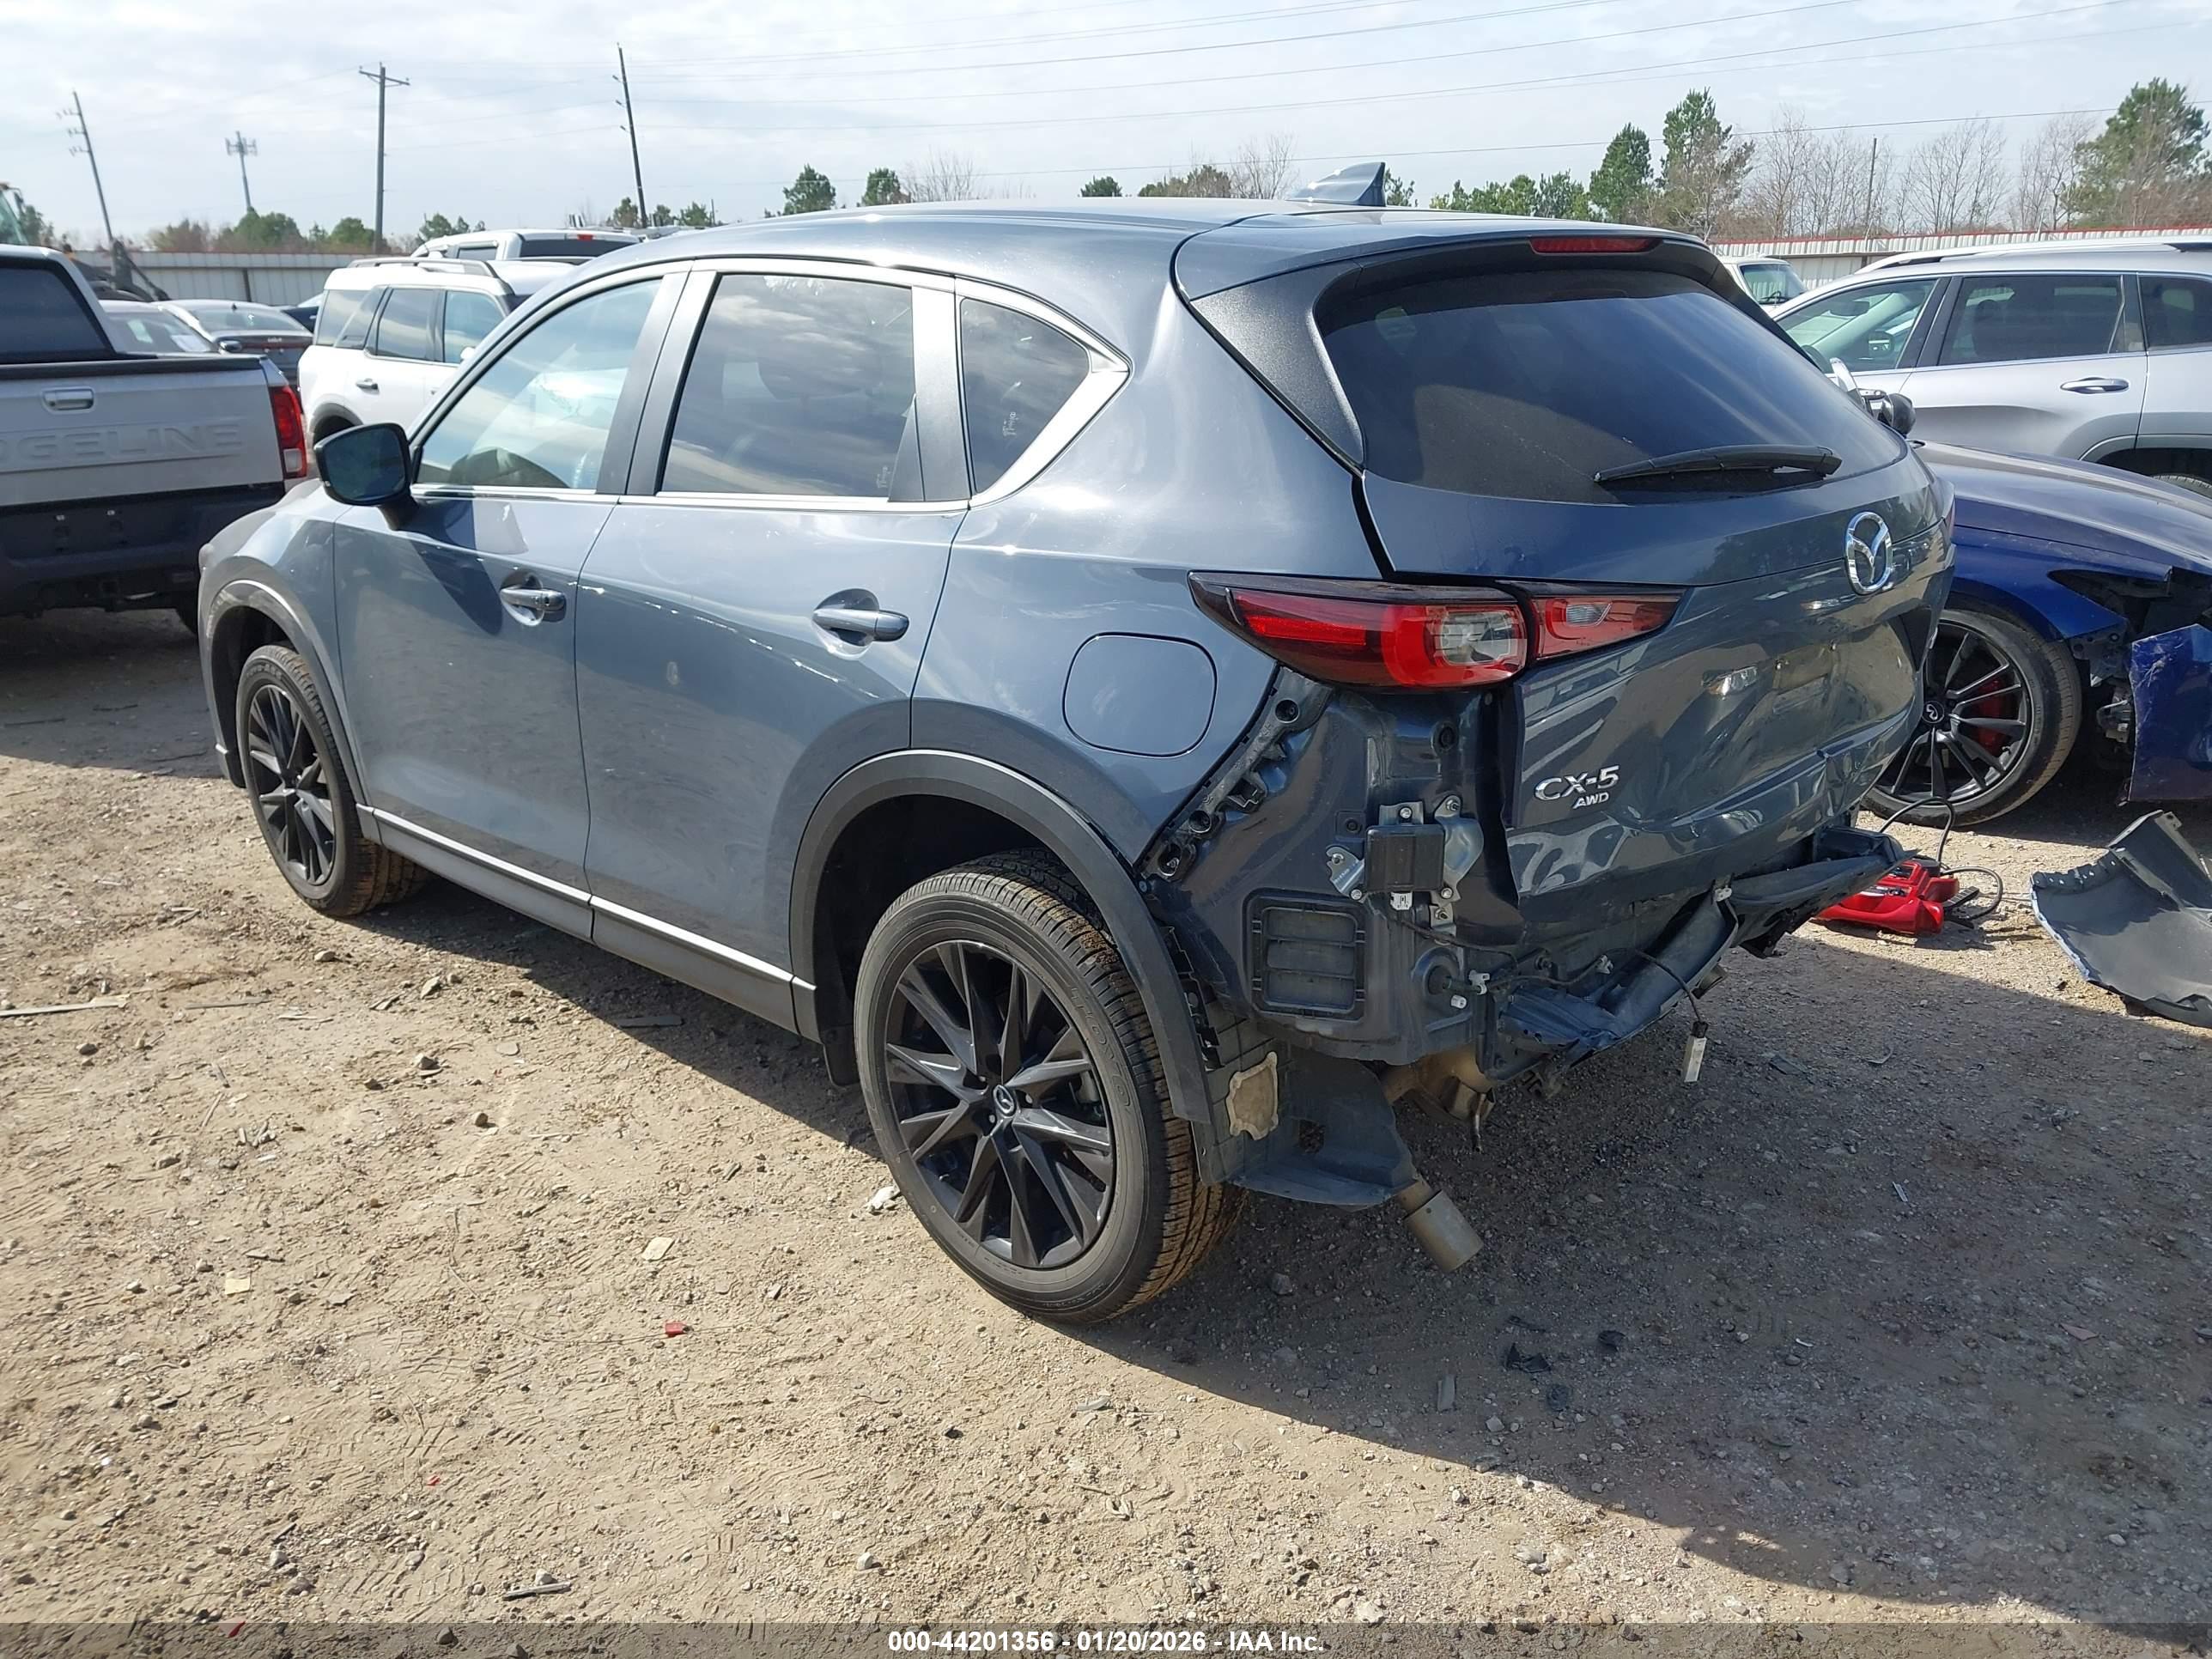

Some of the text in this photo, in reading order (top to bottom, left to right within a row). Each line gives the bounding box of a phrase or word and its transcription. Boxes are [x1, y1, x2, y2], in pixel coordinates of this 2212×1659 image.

[0, 422, 245, 464] GELINE
[1534, 765, 1620, 801] CX-5
[1572, 792, 1609, 809] AWD
